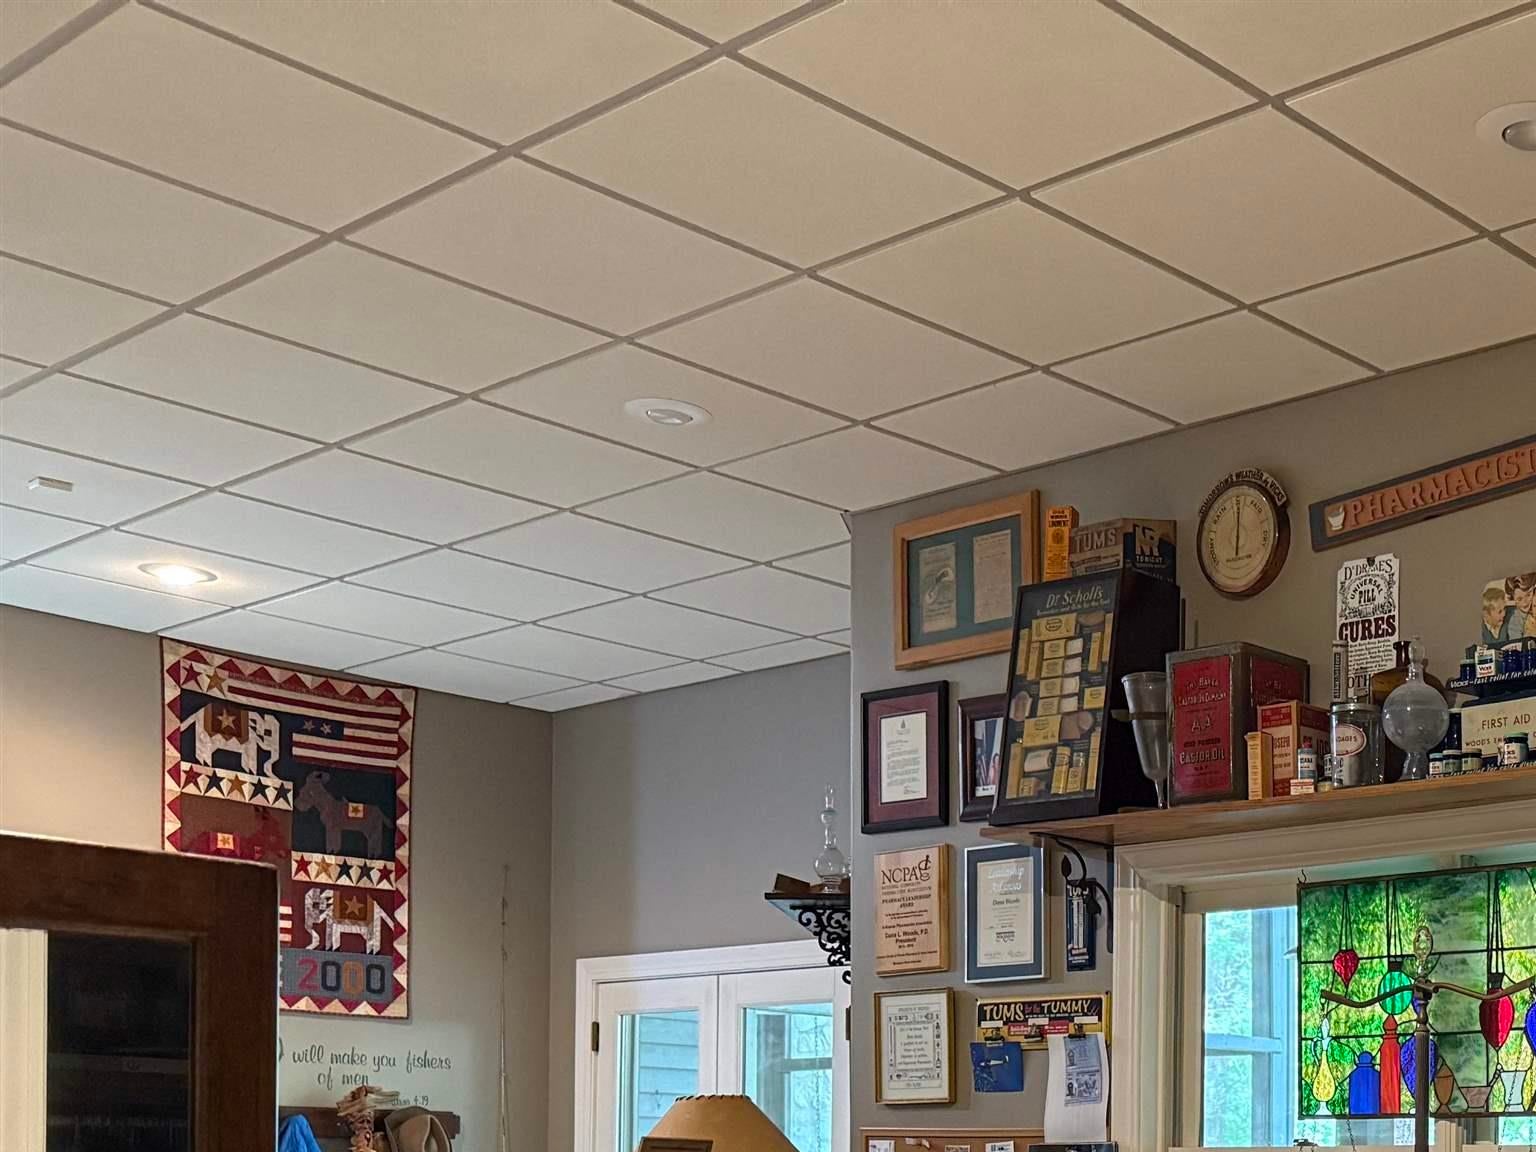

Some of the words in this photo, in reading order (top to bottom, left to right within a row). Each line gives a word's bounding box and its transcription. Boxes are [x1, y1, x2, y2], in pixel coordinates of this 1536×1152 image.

[1074, 528, 1117, 554] TUMS
[1062, 585, 1104, 606] Scholl's
[1350, 578, 1383, 600] UNIVERSAL
[1358, 588, 1376, 604] PILL
[1338, 614, 1397, 643] CURES
[1489, 671, 1510, 682] relief
[1510, 670, 1521, 678] for
[1481, 716, 1508, 730] FIRST
[1513, 714, 1531, 726] AID
[881, 866, 919, 885] NCPA
[297, 957, 386, 995] 2000
[983, 1003, 1025, 1022] TUMS
[1041, 1000, 1091, 1014] TUMMY
[292, 1045, 324, 1064] will
[330, 1048, 368, 1065] make
[373, 1056, 397, 1073] you
[406, 1050, 452, 1074] fishers
[317, 1067, 334, 1090] of
[342, 1072, 369, 1087] men
